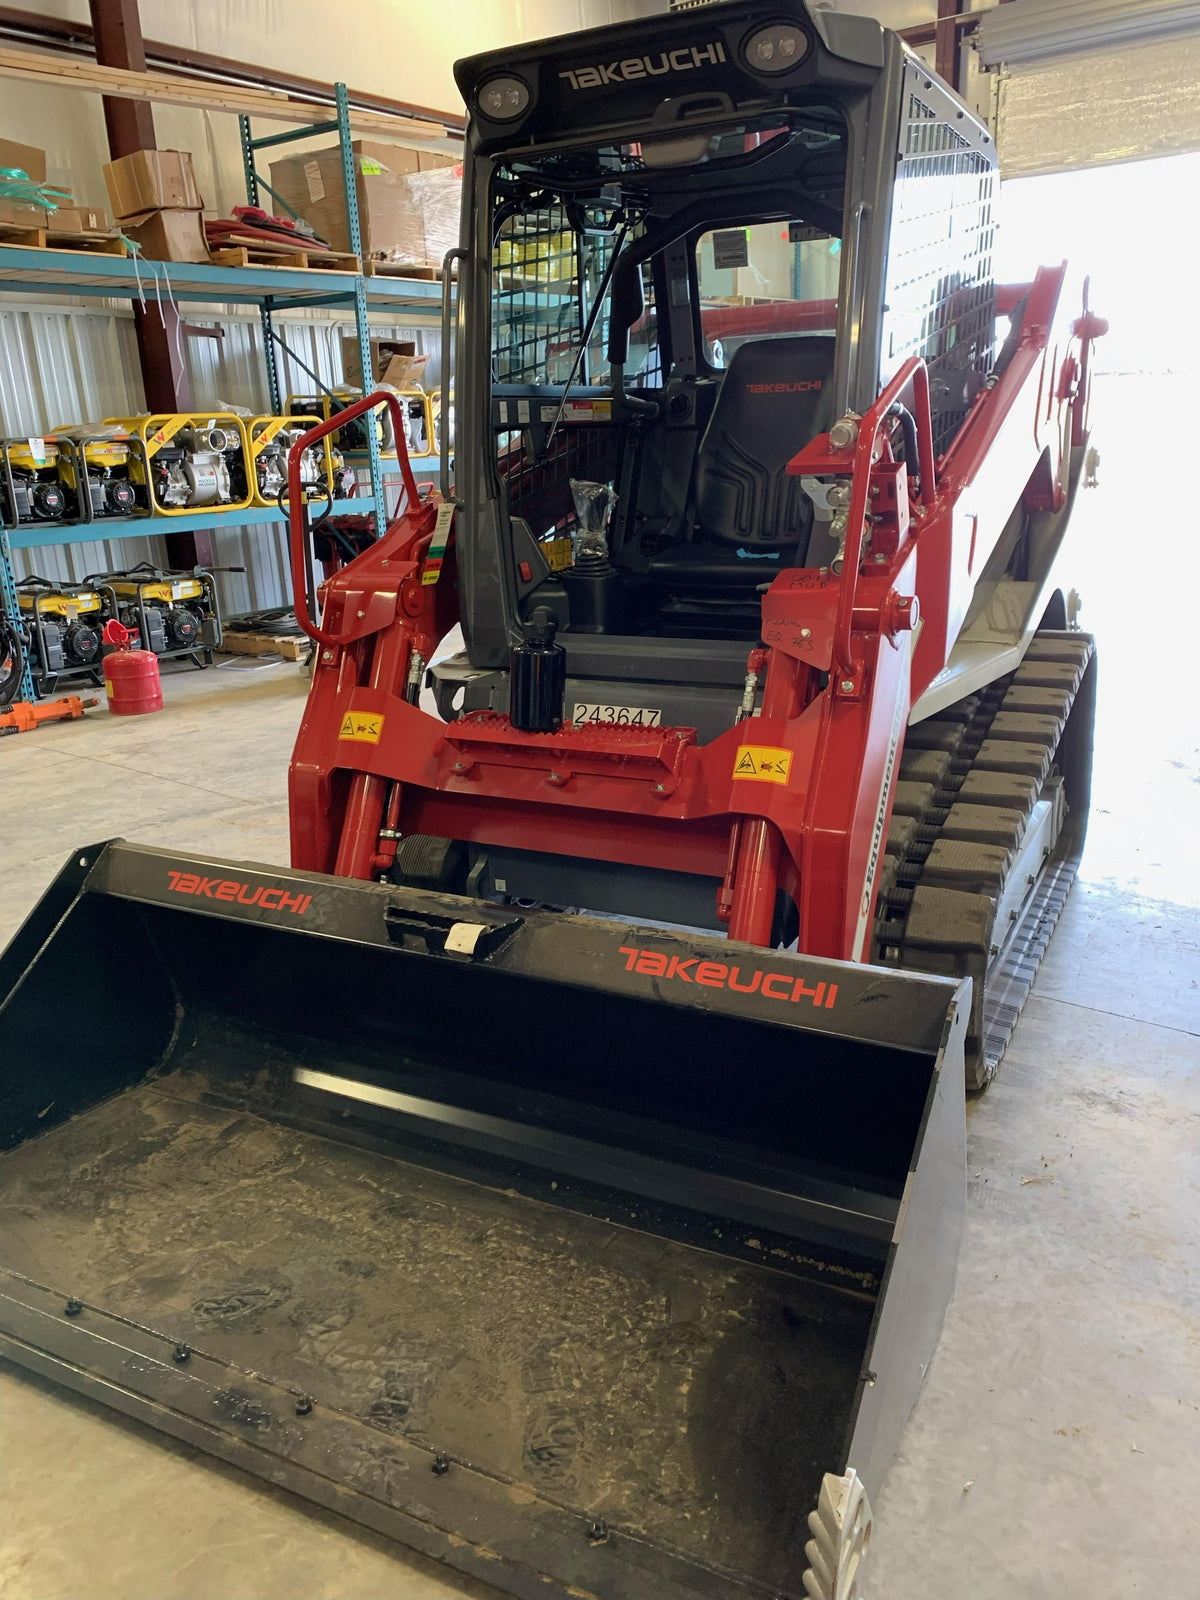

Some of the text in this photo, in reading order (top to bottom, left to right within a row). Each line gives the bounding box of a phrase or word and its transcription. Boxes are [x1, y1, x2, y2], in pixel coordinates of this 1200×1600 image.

[559, 42, 726, 89] TAKEUCHI
[746, 380, 822, 393] TAKEUCHI
[575, 705, 660, 725] 243647
[167, 871, 312, 915] TAKEUCHI
[619, 947, 838, 1008] TAKEUCHI
